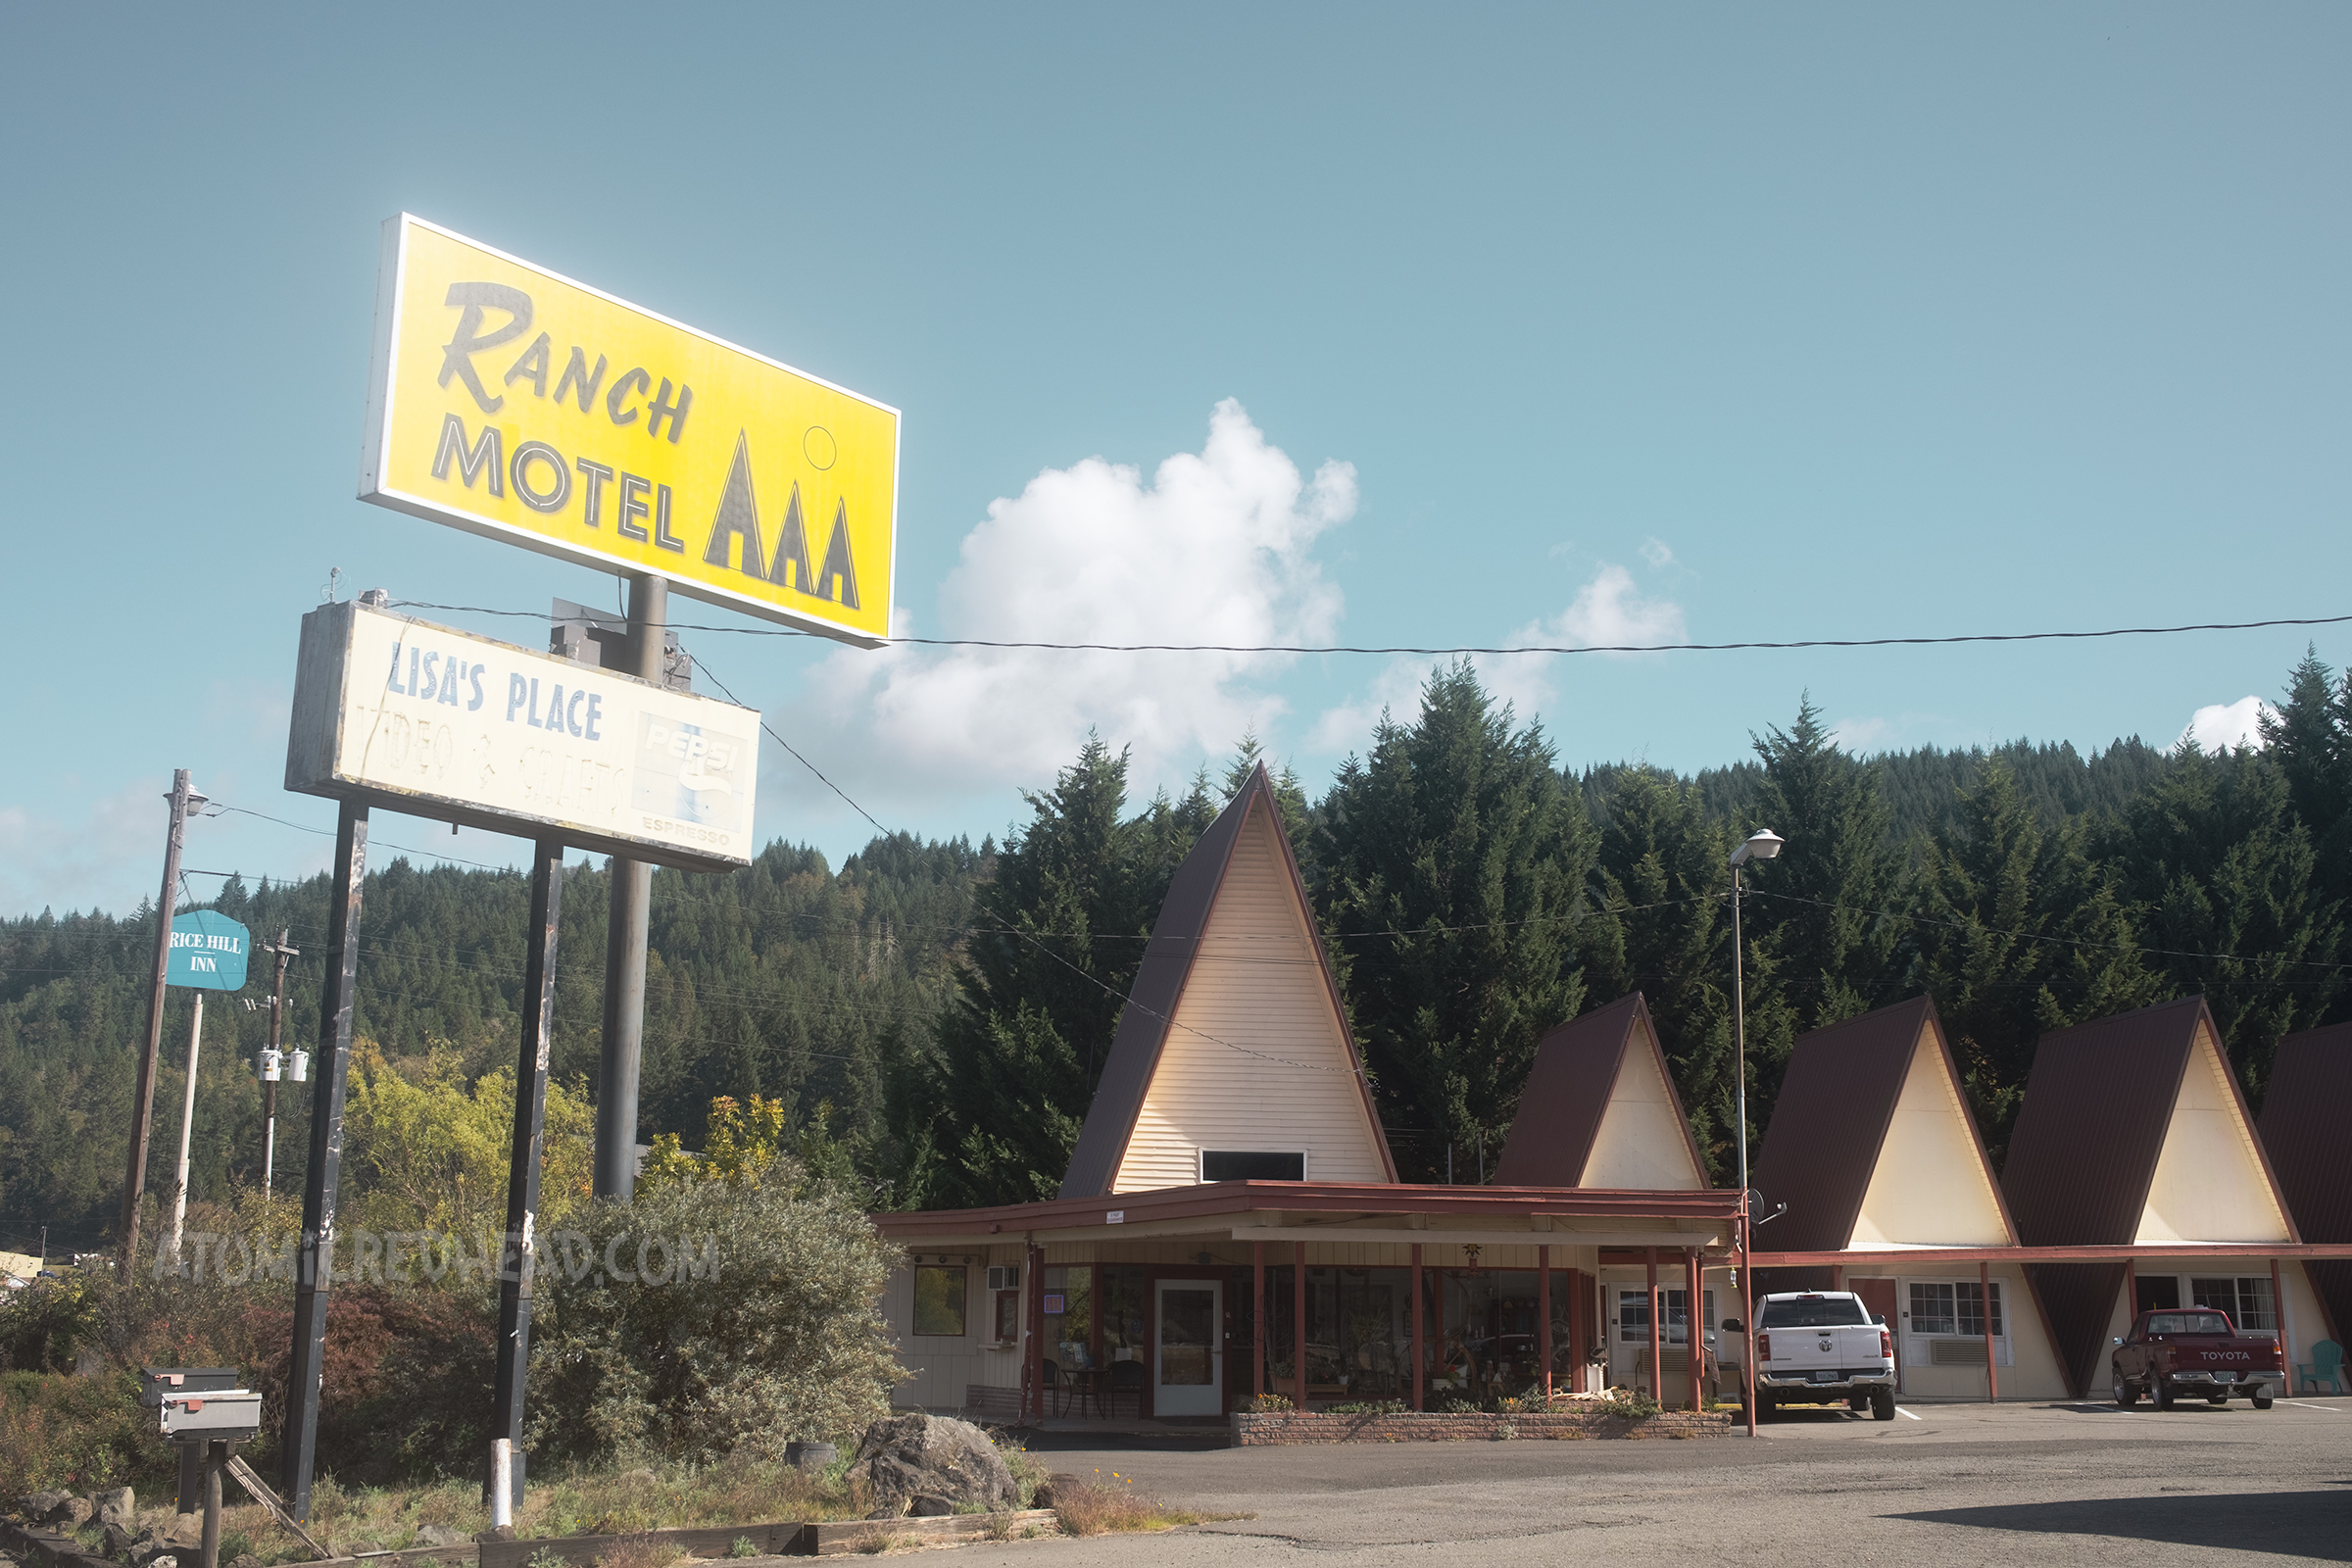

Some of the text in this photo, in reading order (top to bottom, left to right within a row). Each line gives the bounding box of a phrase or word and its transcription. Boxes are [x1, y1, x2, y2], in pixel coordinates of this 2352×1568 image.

[438, 282, 693, 444] RANCH
[431, 413, 684, 554] MOTEL
[389, 642, 602, 741] LISA'S PLACE
[645, 723, 739, 772] PEPSI
[642, 816, 730, 846] ESPRESSO
[170, 932, 241, 955] RICE HILL
[190, 956, 217, 972] INN
[2200, 1351, 2251, 1361] TOYOTA
